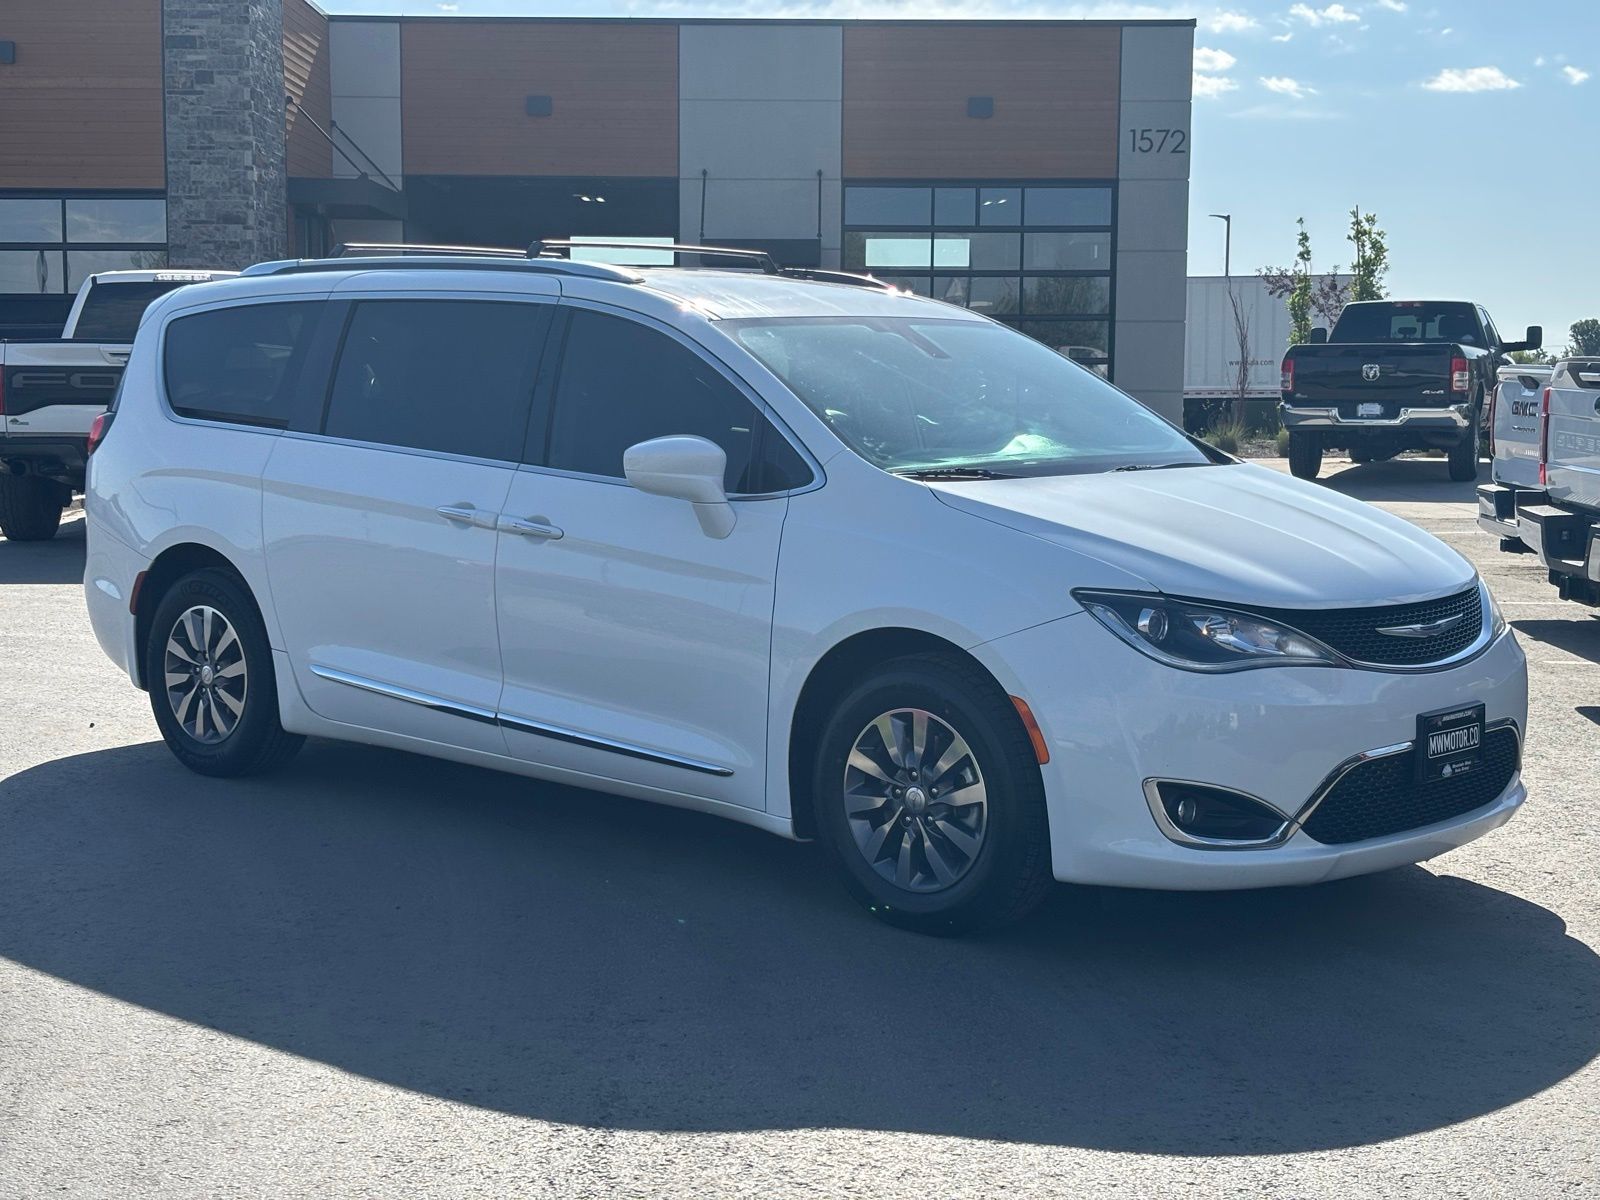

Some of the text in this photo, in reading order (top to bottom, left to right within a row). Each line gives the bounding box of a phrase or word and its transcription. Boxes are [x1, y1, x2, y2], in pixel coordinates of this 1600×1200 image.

[1129, 129, 1186, 153] 1572
[1511, 401, 1539, 417] GMC
[1429, 726, 1479, 755] MWMOTOR.CO
